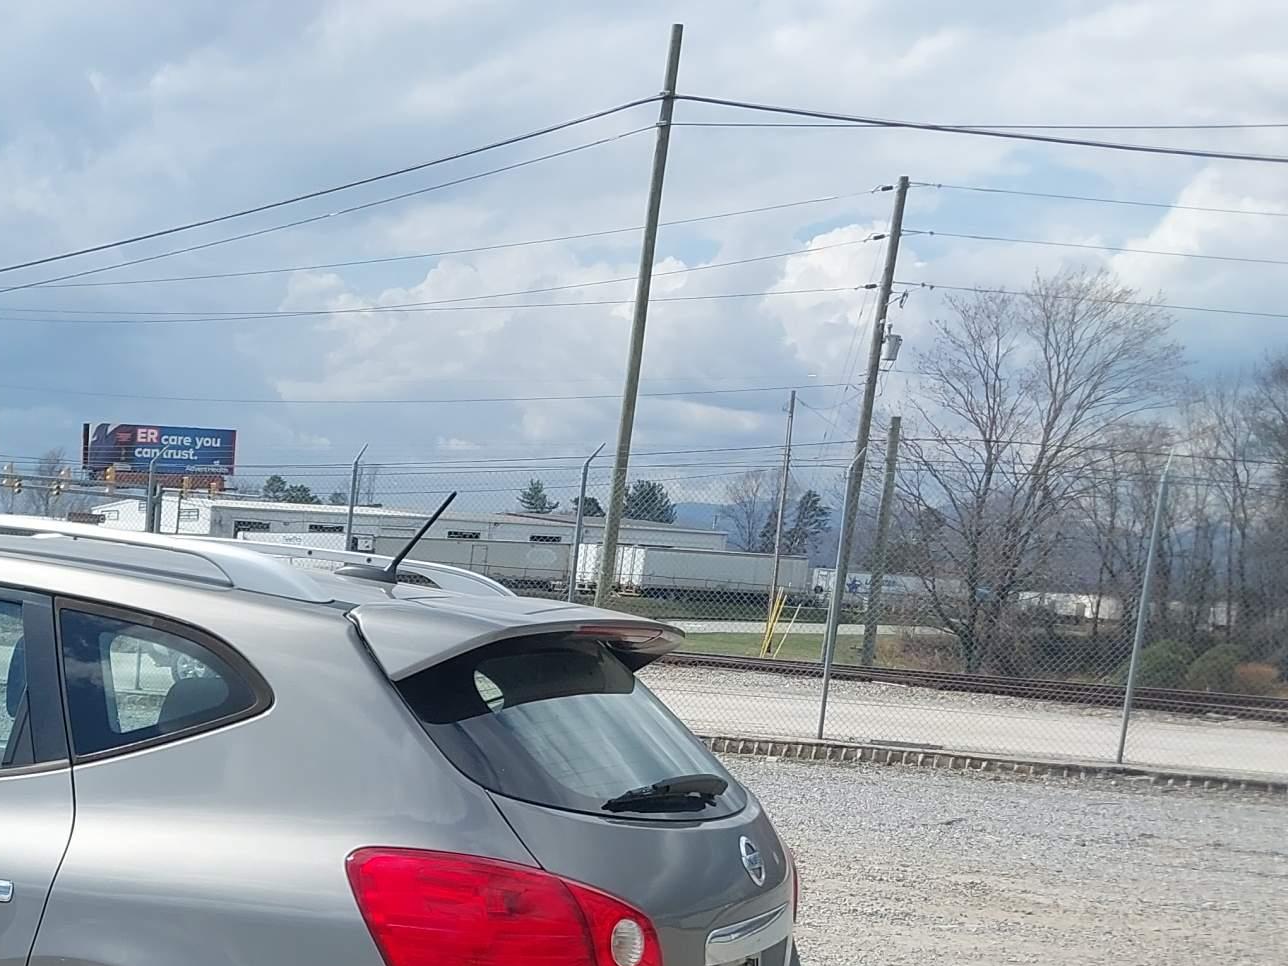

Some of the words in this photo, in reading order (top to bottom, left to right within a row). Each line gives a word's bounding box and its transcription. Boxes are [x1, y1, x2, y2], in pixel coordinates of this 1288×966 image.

[137, 428, 158, 443] ER
[161, 435, 192, 446] care
[195, 436, 221, 449] you
[134, 448, 159, 458] can
